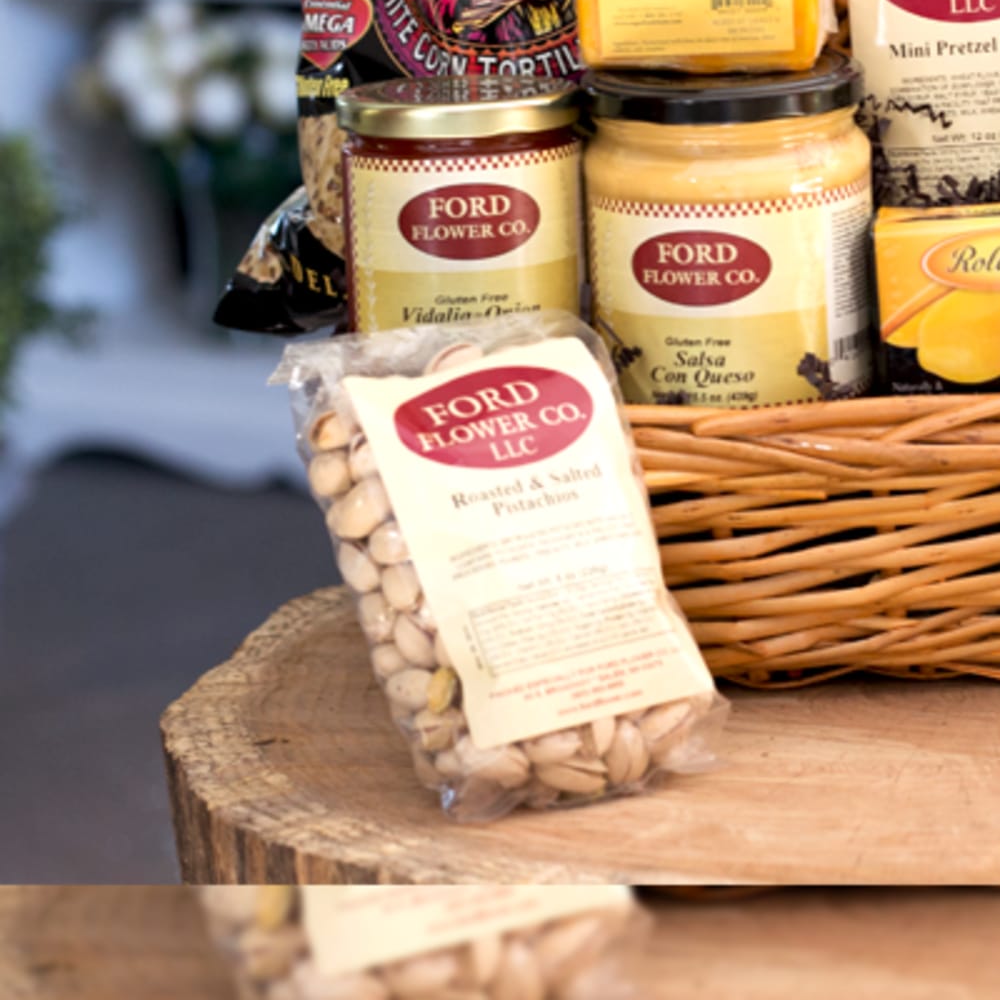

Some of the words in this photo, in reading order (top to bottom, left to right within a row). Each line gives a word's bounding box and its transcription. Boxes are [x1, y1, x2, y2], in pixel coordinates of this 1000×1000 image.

[302, 12, 356, 34] MEGA
[413, 32, 468, 77] CORN
[477, 38, 583, 78] TORTIL
[889, 42, 931, 60] Mini
[936, 36, 998, 58] Pretzel
[428, 193, 512, 219] FORD
[410, 222, 495, 243] FLOWER
[498, 218, 532, 238] CO.
[657, 242, 739, 265] FORD
[642, 268, 721, 286] FLOWER
[724, 268, 762, 285] CO.
[434, 294, 478, 305] Gluten
[480, 293, 509, 302] Free
[664, 336, 702, 347] Gluten
[705, 336, 732, 347] Free
[673, 350, 727, 368] Salsa
[650, 366, 688, 384] Con
[693, 368, 756, 389] Queso
[422, 379, 541, 429] FORD
[415, 411, 537, 454] FLOWER
[538, 400, 588, 427] CO.
[488, 434, 540, 463] LLC
[450, 479, 524, 510] Roasted
[548, 463, 604, 485] Salted
[492, 490, 580, 517] Pistachios
